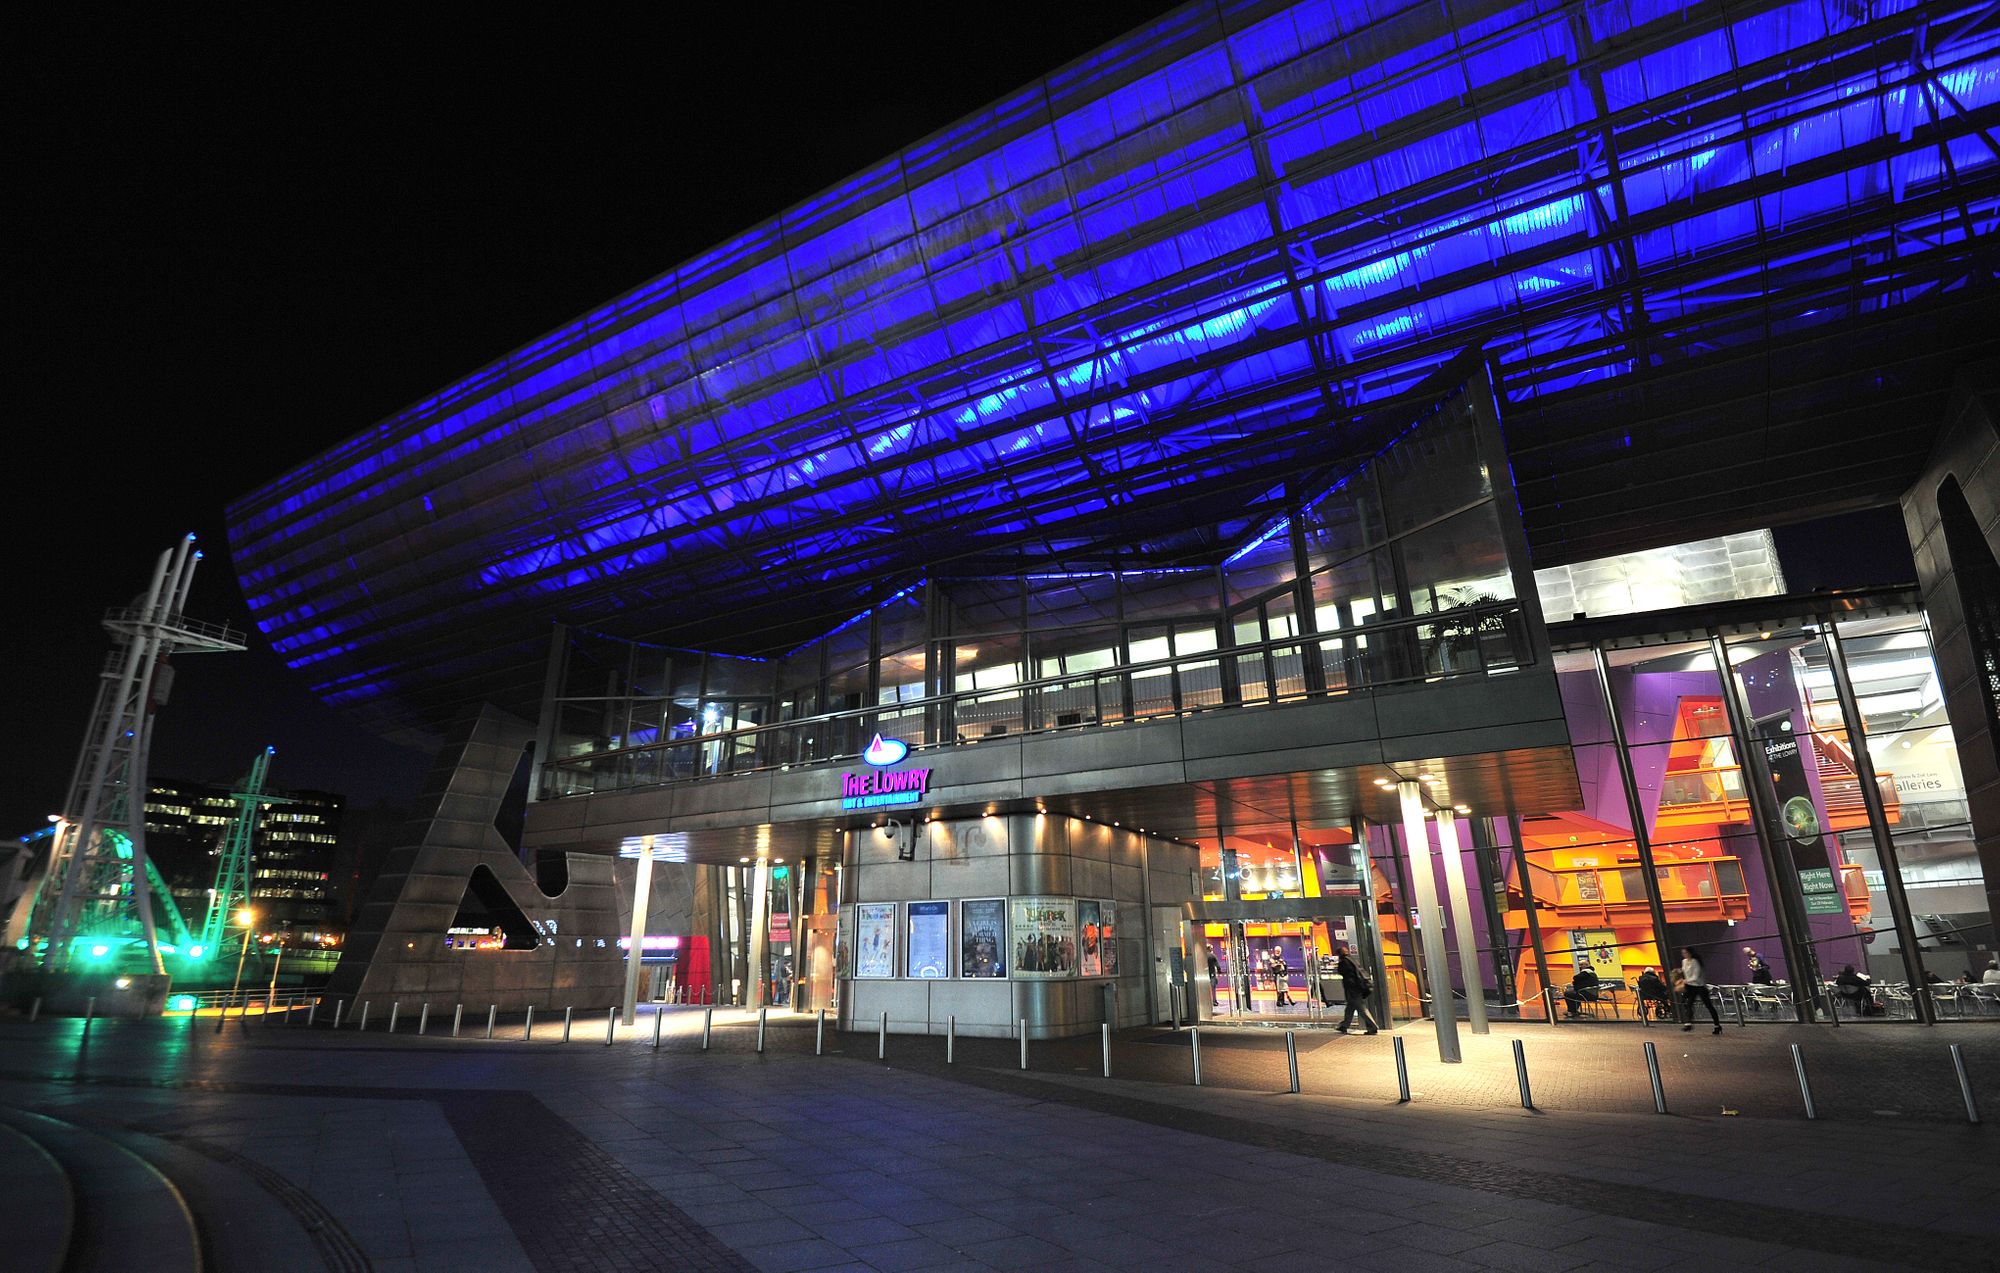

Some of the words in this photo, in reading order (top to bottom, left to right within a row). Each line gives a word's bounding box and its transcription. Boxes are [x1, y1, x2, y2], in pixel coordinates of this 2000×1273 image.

[1765, 742, 1797, 755] Exhibitions
[1782, 749, 1798, 758] LOWRY
[842, 773, 869, 796] THE
[873, 768, 929, 794] LOWRY
[1896, 779, 1942, 792] alleries
[1800, 871, 1816, 881] Right
[1816, 871, 1831, 879] Here
[1803, 882, 1819, 892] Right
